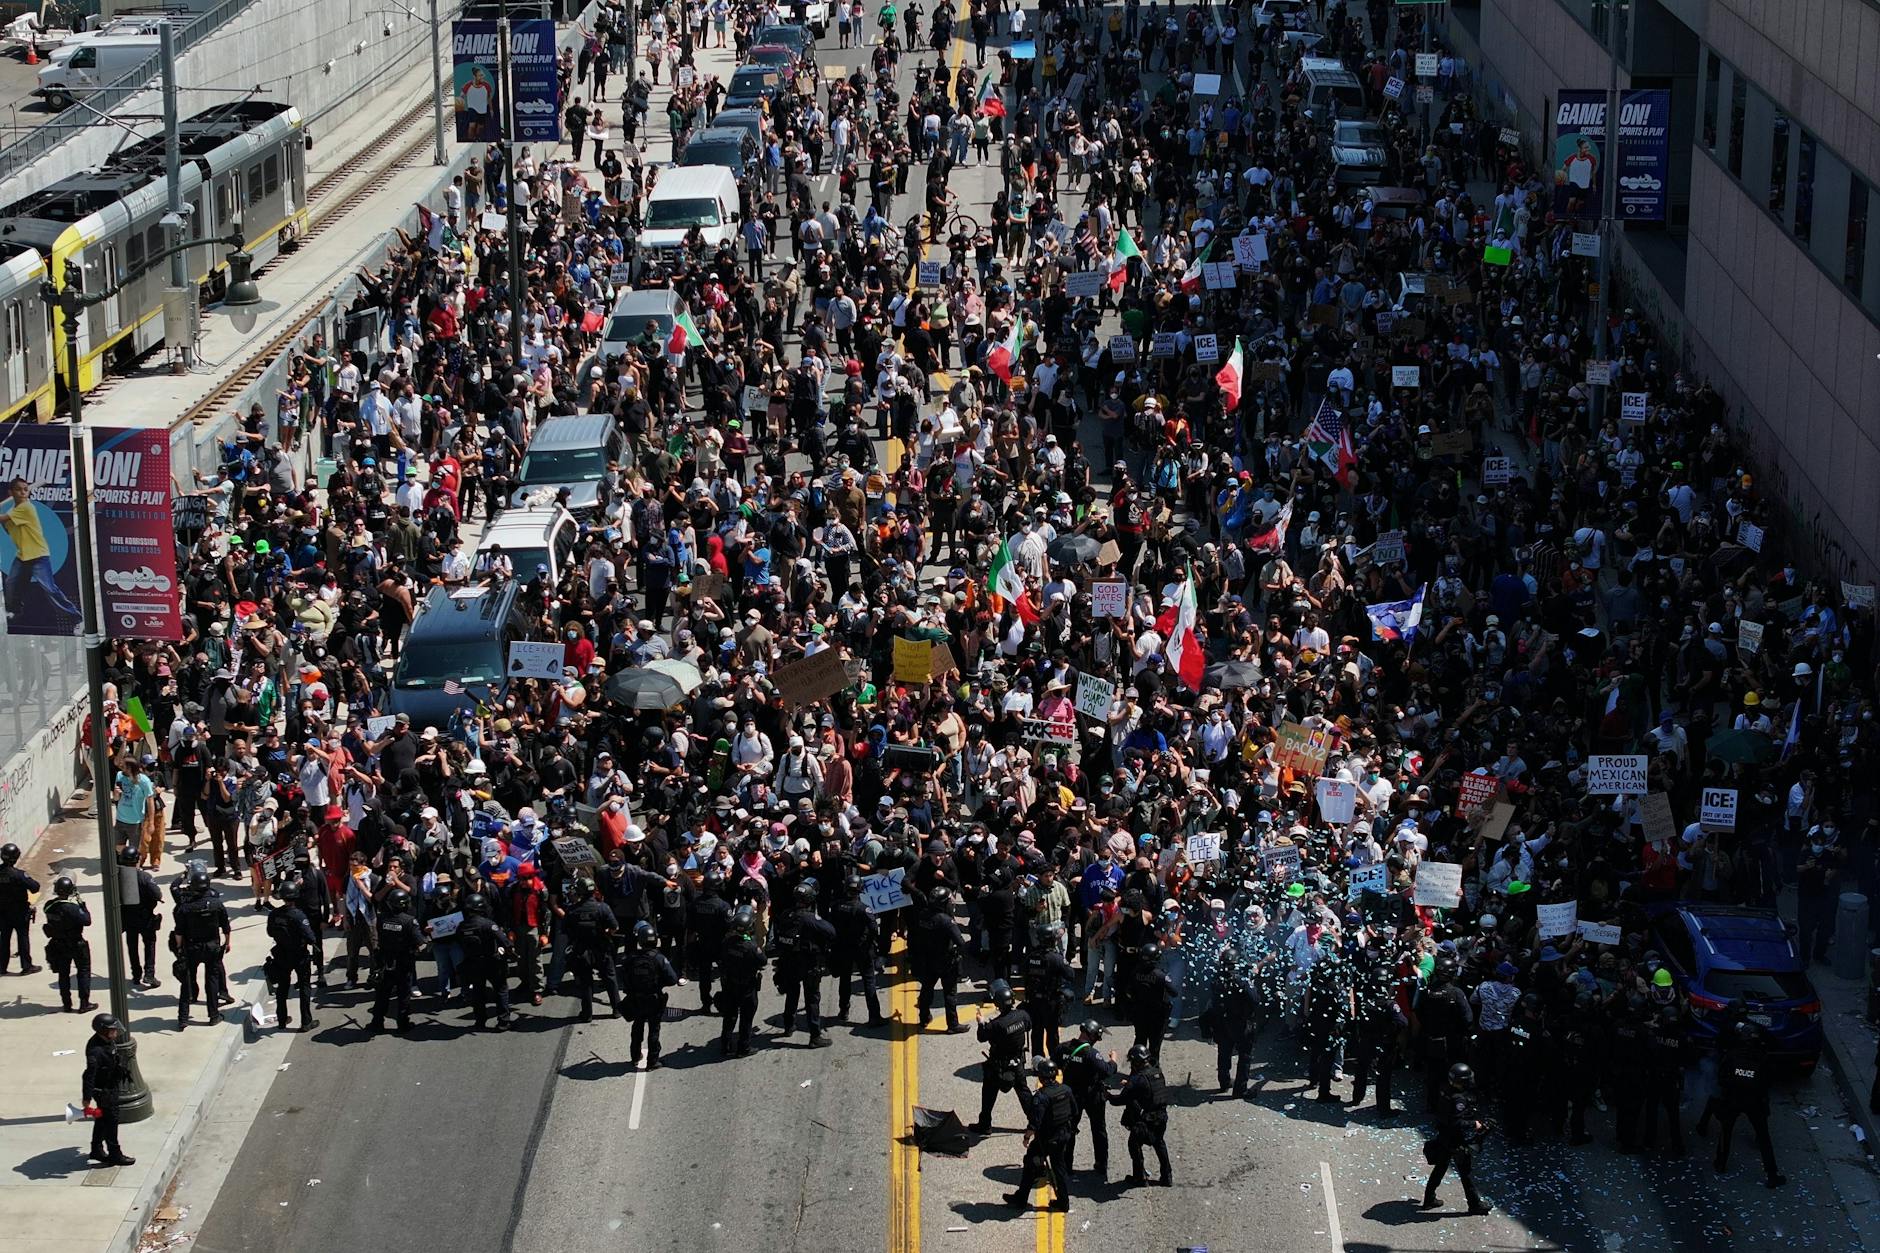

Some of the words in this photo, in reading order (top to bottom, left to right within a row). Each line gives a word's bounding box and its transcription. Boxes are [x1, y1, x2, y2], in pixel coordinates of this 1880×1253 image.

[453, 33, 497, 55] GAME
[511, 32, 539, 52] ON!
[510, 54, 533, 64] SPORTS
[533, 55, 538, 64] &
[538, 55, 553, 64] PLAY
[1557, 102, 1606, 125] GAME
[1620, 103, 1652, 126] ON!
[1618, 126, 1642, 136] SPORTS
[1642, 127, 1648, 136] &
[1648, 127, 1664, 136] PLAY
[1196, 338, 1216, 349] ICE:
[1623, 396, 1644, 407] ICE:
[0, 447, 70, 485] GAME
[94, 450, 142, 488] ON!
[1486, 460, 1508, 470] ICE:
[94, 488, 130, 504] SPORTS
[130, 490, 140, 504] &
[141, 491, 166, 506] PLAY
[105, 509, 167, 520] EXHIBITION
[1377, 549, 1398, 560] NO
[1098, 585, 1119, 594] GOD
[1094, 594, 1122, 602] HATES
[1100, 603, 1116, 612] ICE
[1079, 674, 1111, 696] NATIONAL
[1083, 690, 1106, 706] GUARD
[1082, 701, 1096, 716] LOL
[1024, 721, 1052, 739] FUCK
[1285, 738, 1315, 758] BACK
[1315, 748, 1326, 761] 2
[1276, 747, 1322, 776] HELL
[1598, 757, 1638, 768] PROUD
[1588, 770, 1646, 781] MEXICAN
[1462, 780, 1496, 793] ILLEGAL
[1590, 781, 1646, 790] AMERICAN
[1704, 792, 1734, 808] ICE:
[558, 846, 589, 854] RIGHTS
[559, 840, 582, 849] FULL
[1190, 836, 1218, 850] FUCK
[1190, 847, 1213, 861] ICE
[1352, 868, 1383, 884] ICE:
[864, 874, 900, 893] FUCK
[870, 890, 904, 910] ICE
[1735, 1068, 1755, 1078] POLICE
